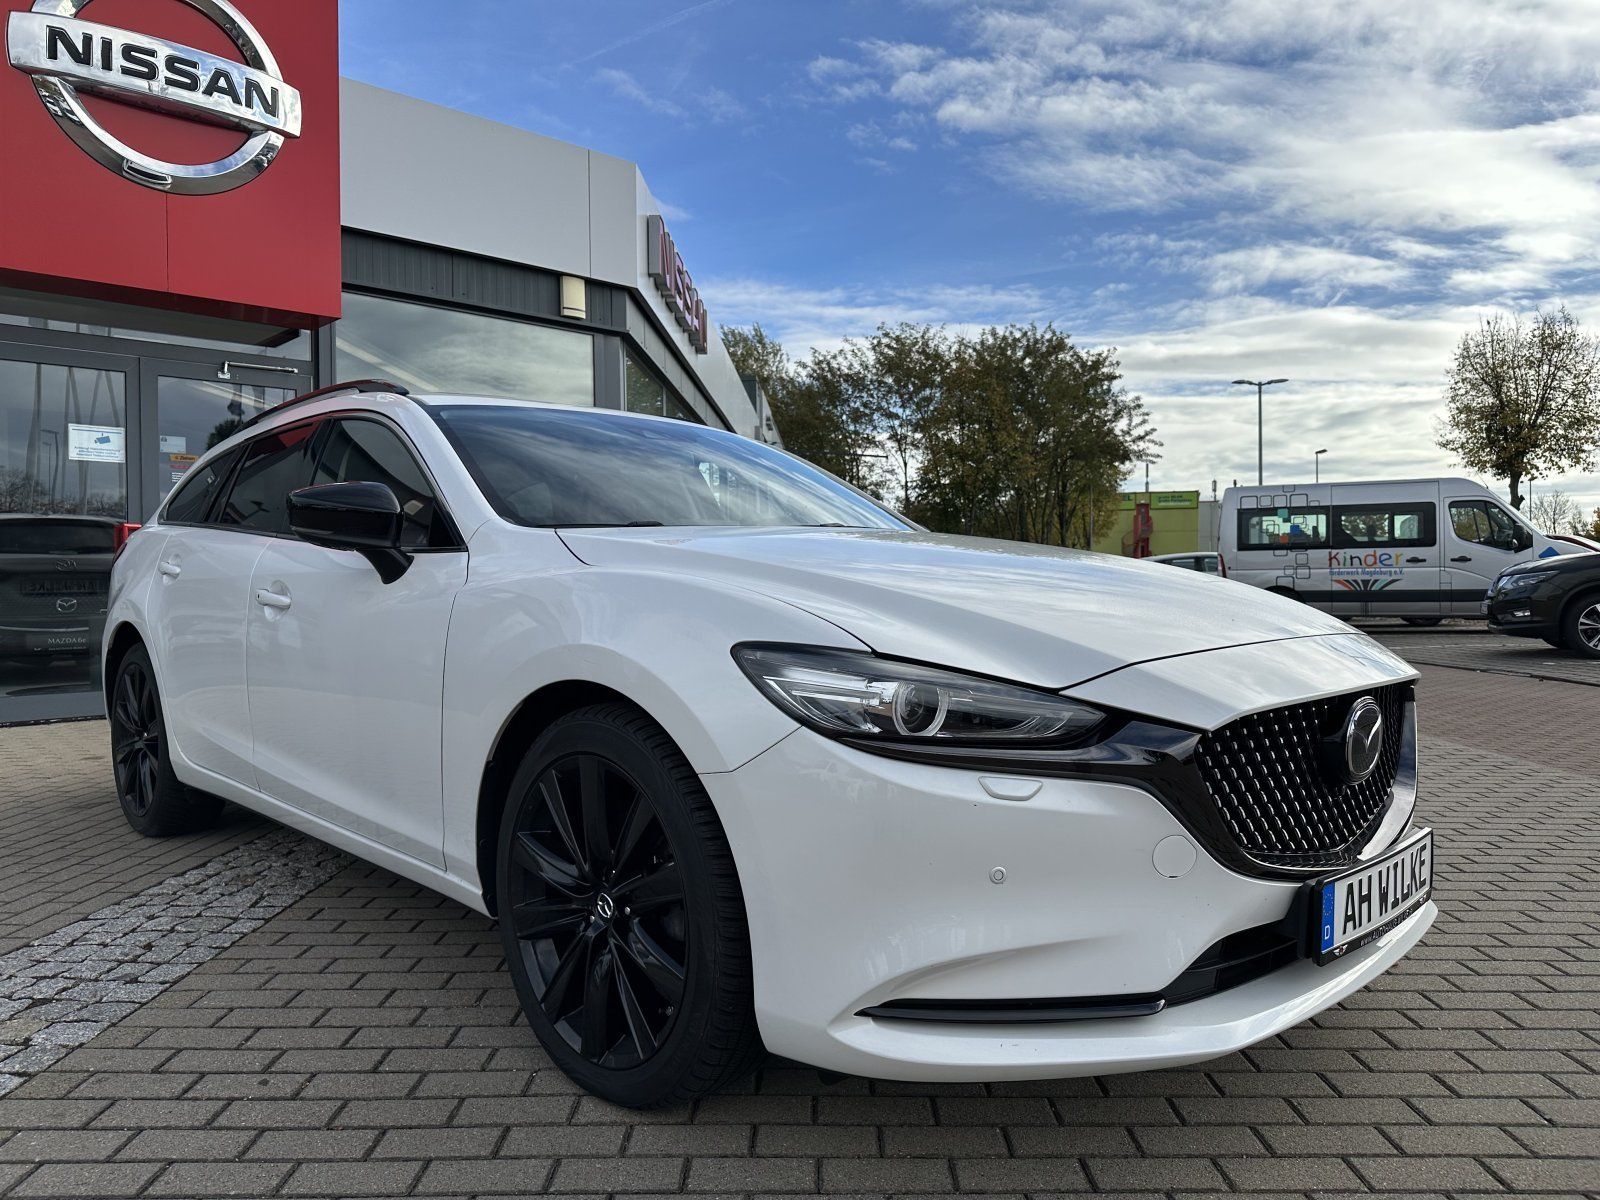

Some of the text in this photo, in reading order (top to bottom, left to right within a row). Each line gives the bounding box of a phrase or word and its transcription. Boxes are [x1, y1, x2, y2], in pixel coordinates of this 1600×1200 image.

[45, 24, 280, 119] NISSAN
[648, 214, 708, 355] NISSAN
[1328, 550, 1403, 567] Kinder
[1361, 568, 1392, 577] Magdeburg
[1343, 842, 1427, 935] AH WILKE
[1324, 924, 1331, 941] D
